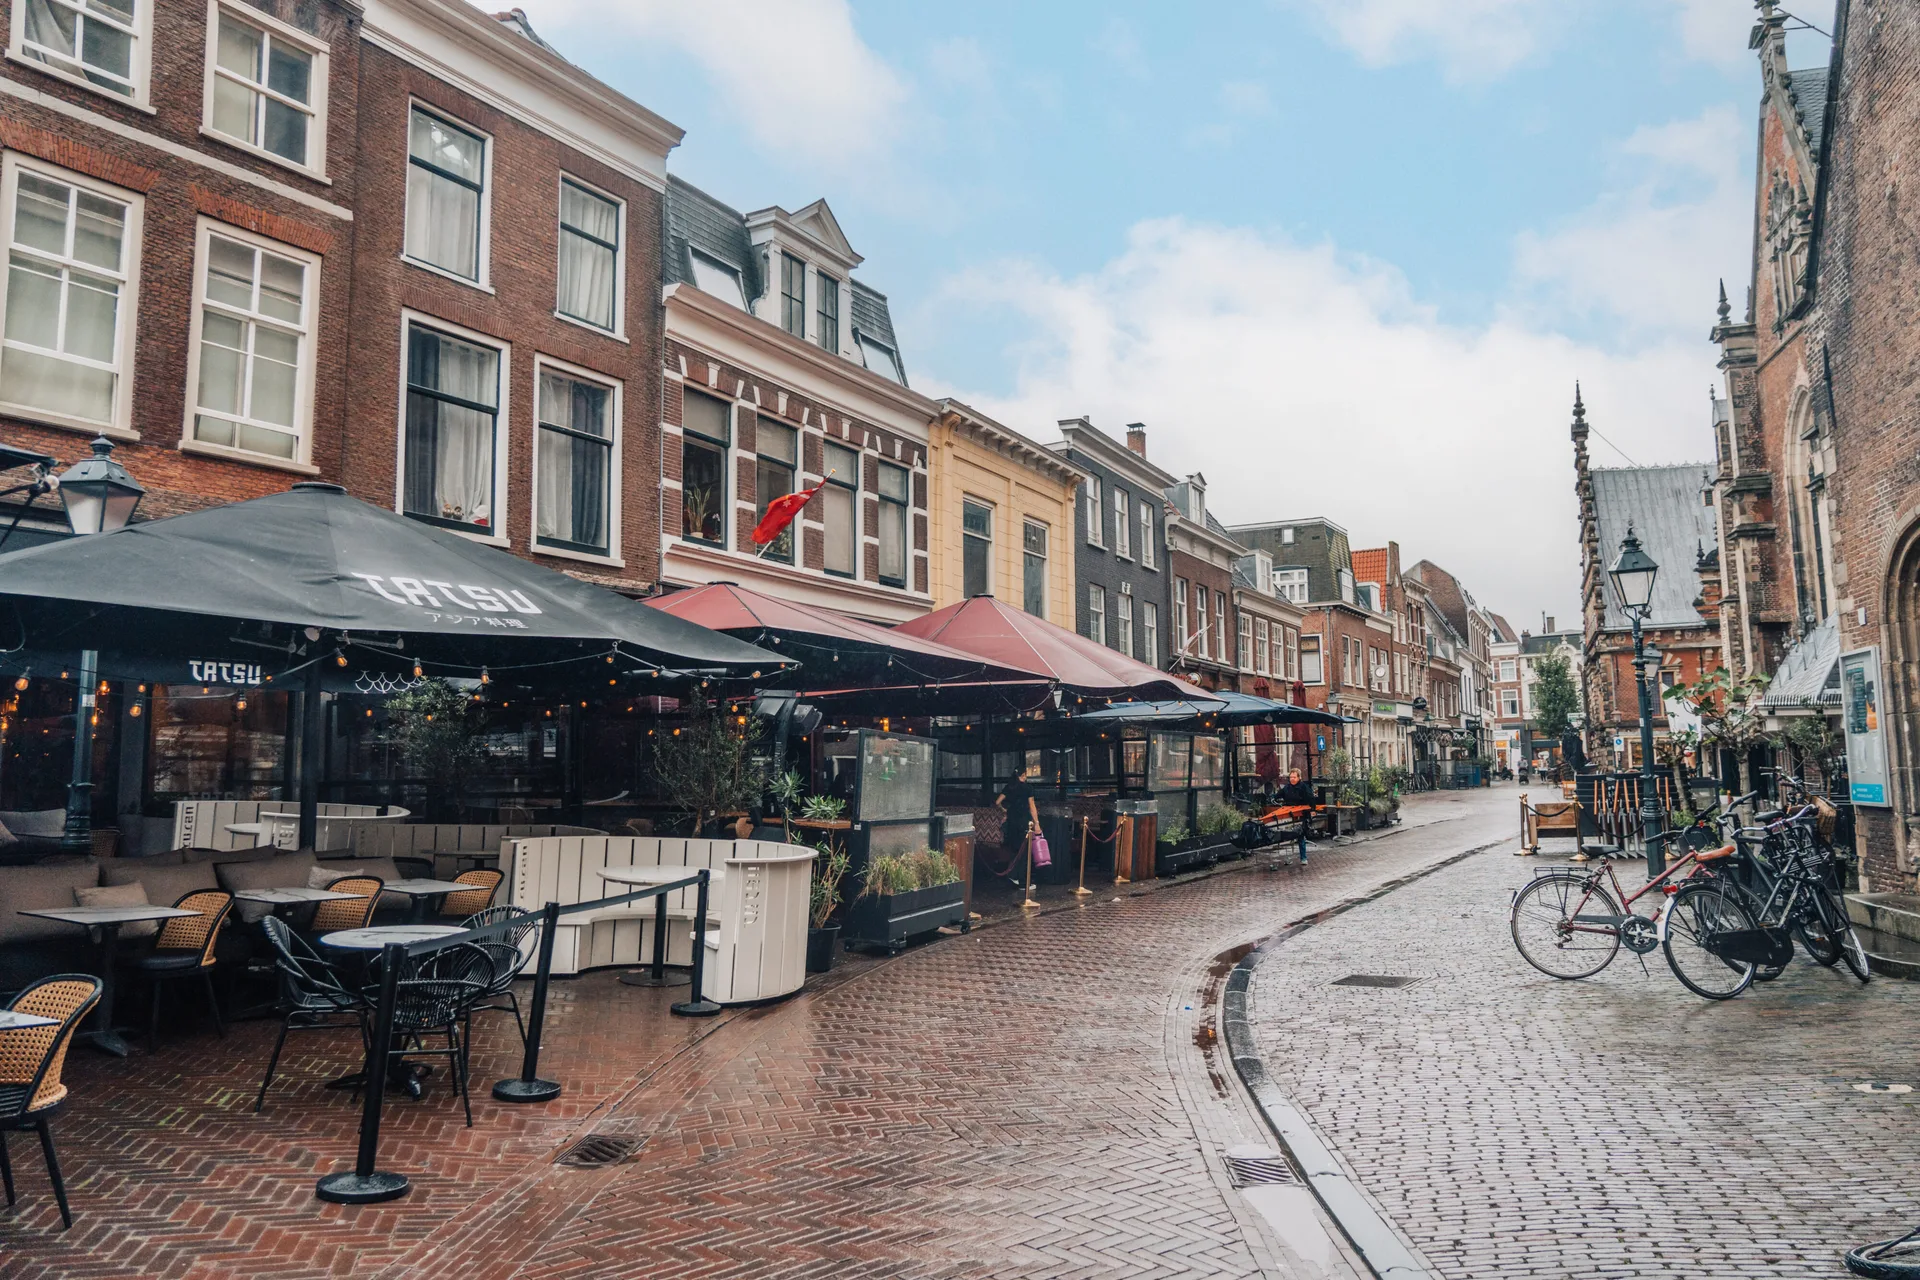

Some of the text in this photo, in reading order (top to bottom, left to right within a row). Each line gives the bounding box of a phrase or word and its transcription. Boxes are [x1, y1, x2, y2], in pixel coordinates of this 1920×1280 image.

[351, 572, 542, 614] TATSU
[424, 611, 529, 628] アジア料理
[189, 660, 261, 684] TATSU
